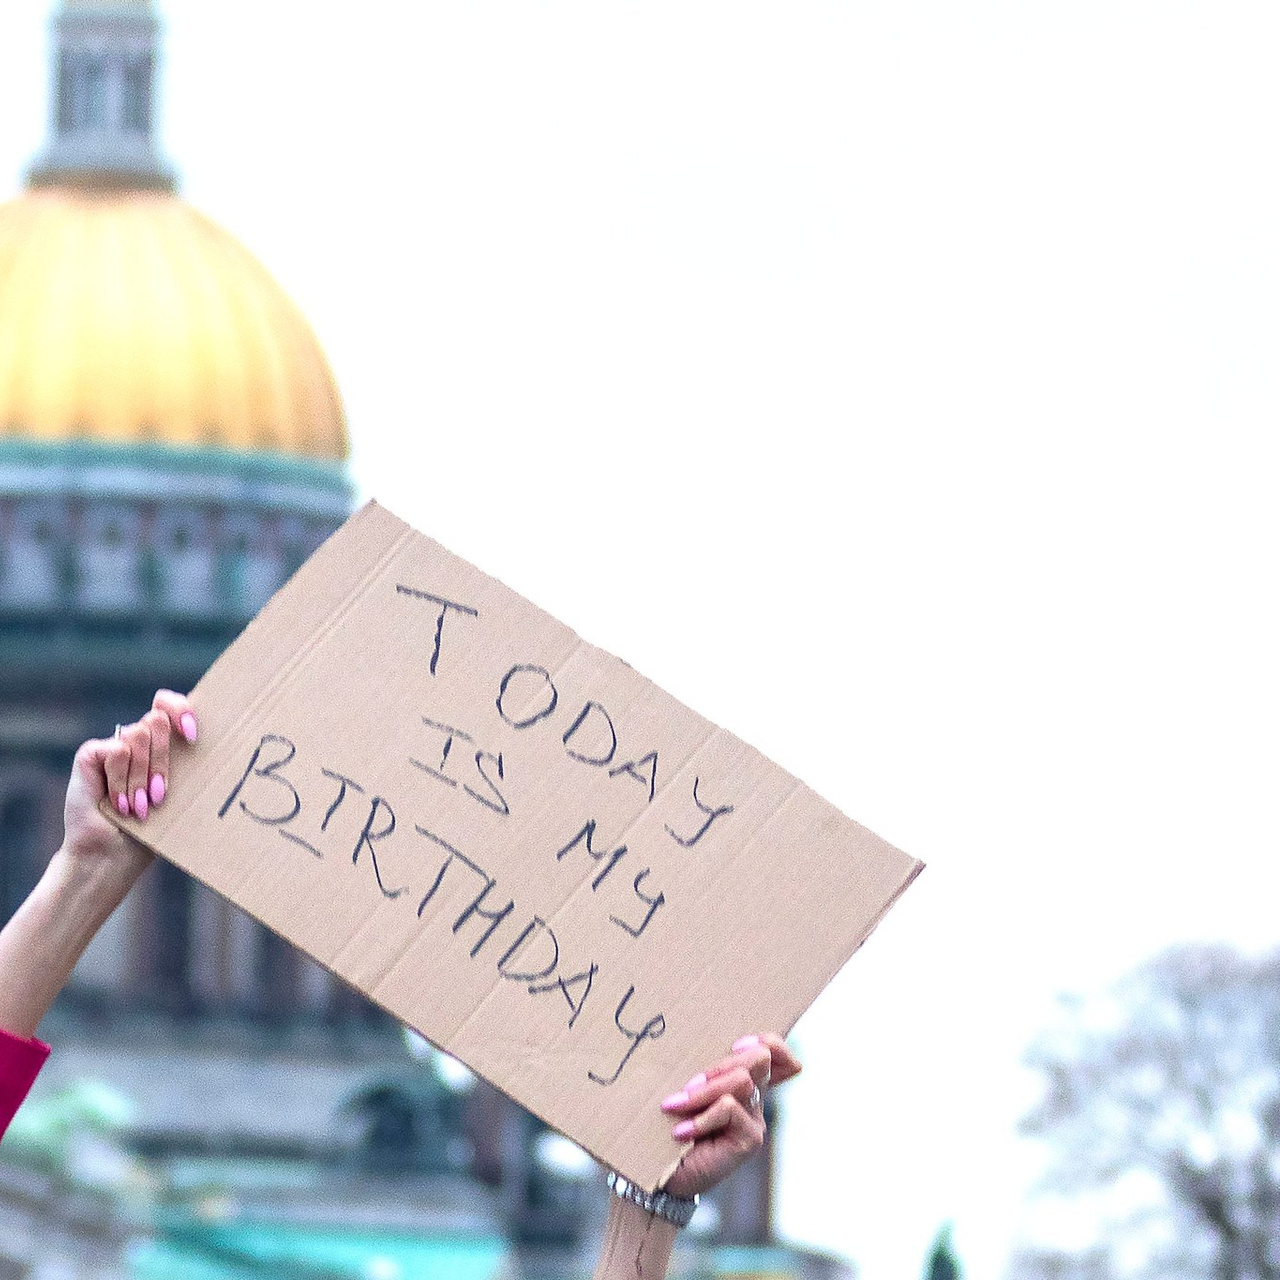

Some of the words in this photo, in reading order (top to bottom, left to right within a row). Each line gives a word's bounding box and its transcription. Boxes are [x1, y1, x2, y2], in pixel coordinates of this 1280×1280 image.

[395, 583, 734, 847] TODAY
[408, 716, 510, 816] IS
[557, 819, 666, 937] MY
[217, 734, 666, 1085] BIRTHDAY
